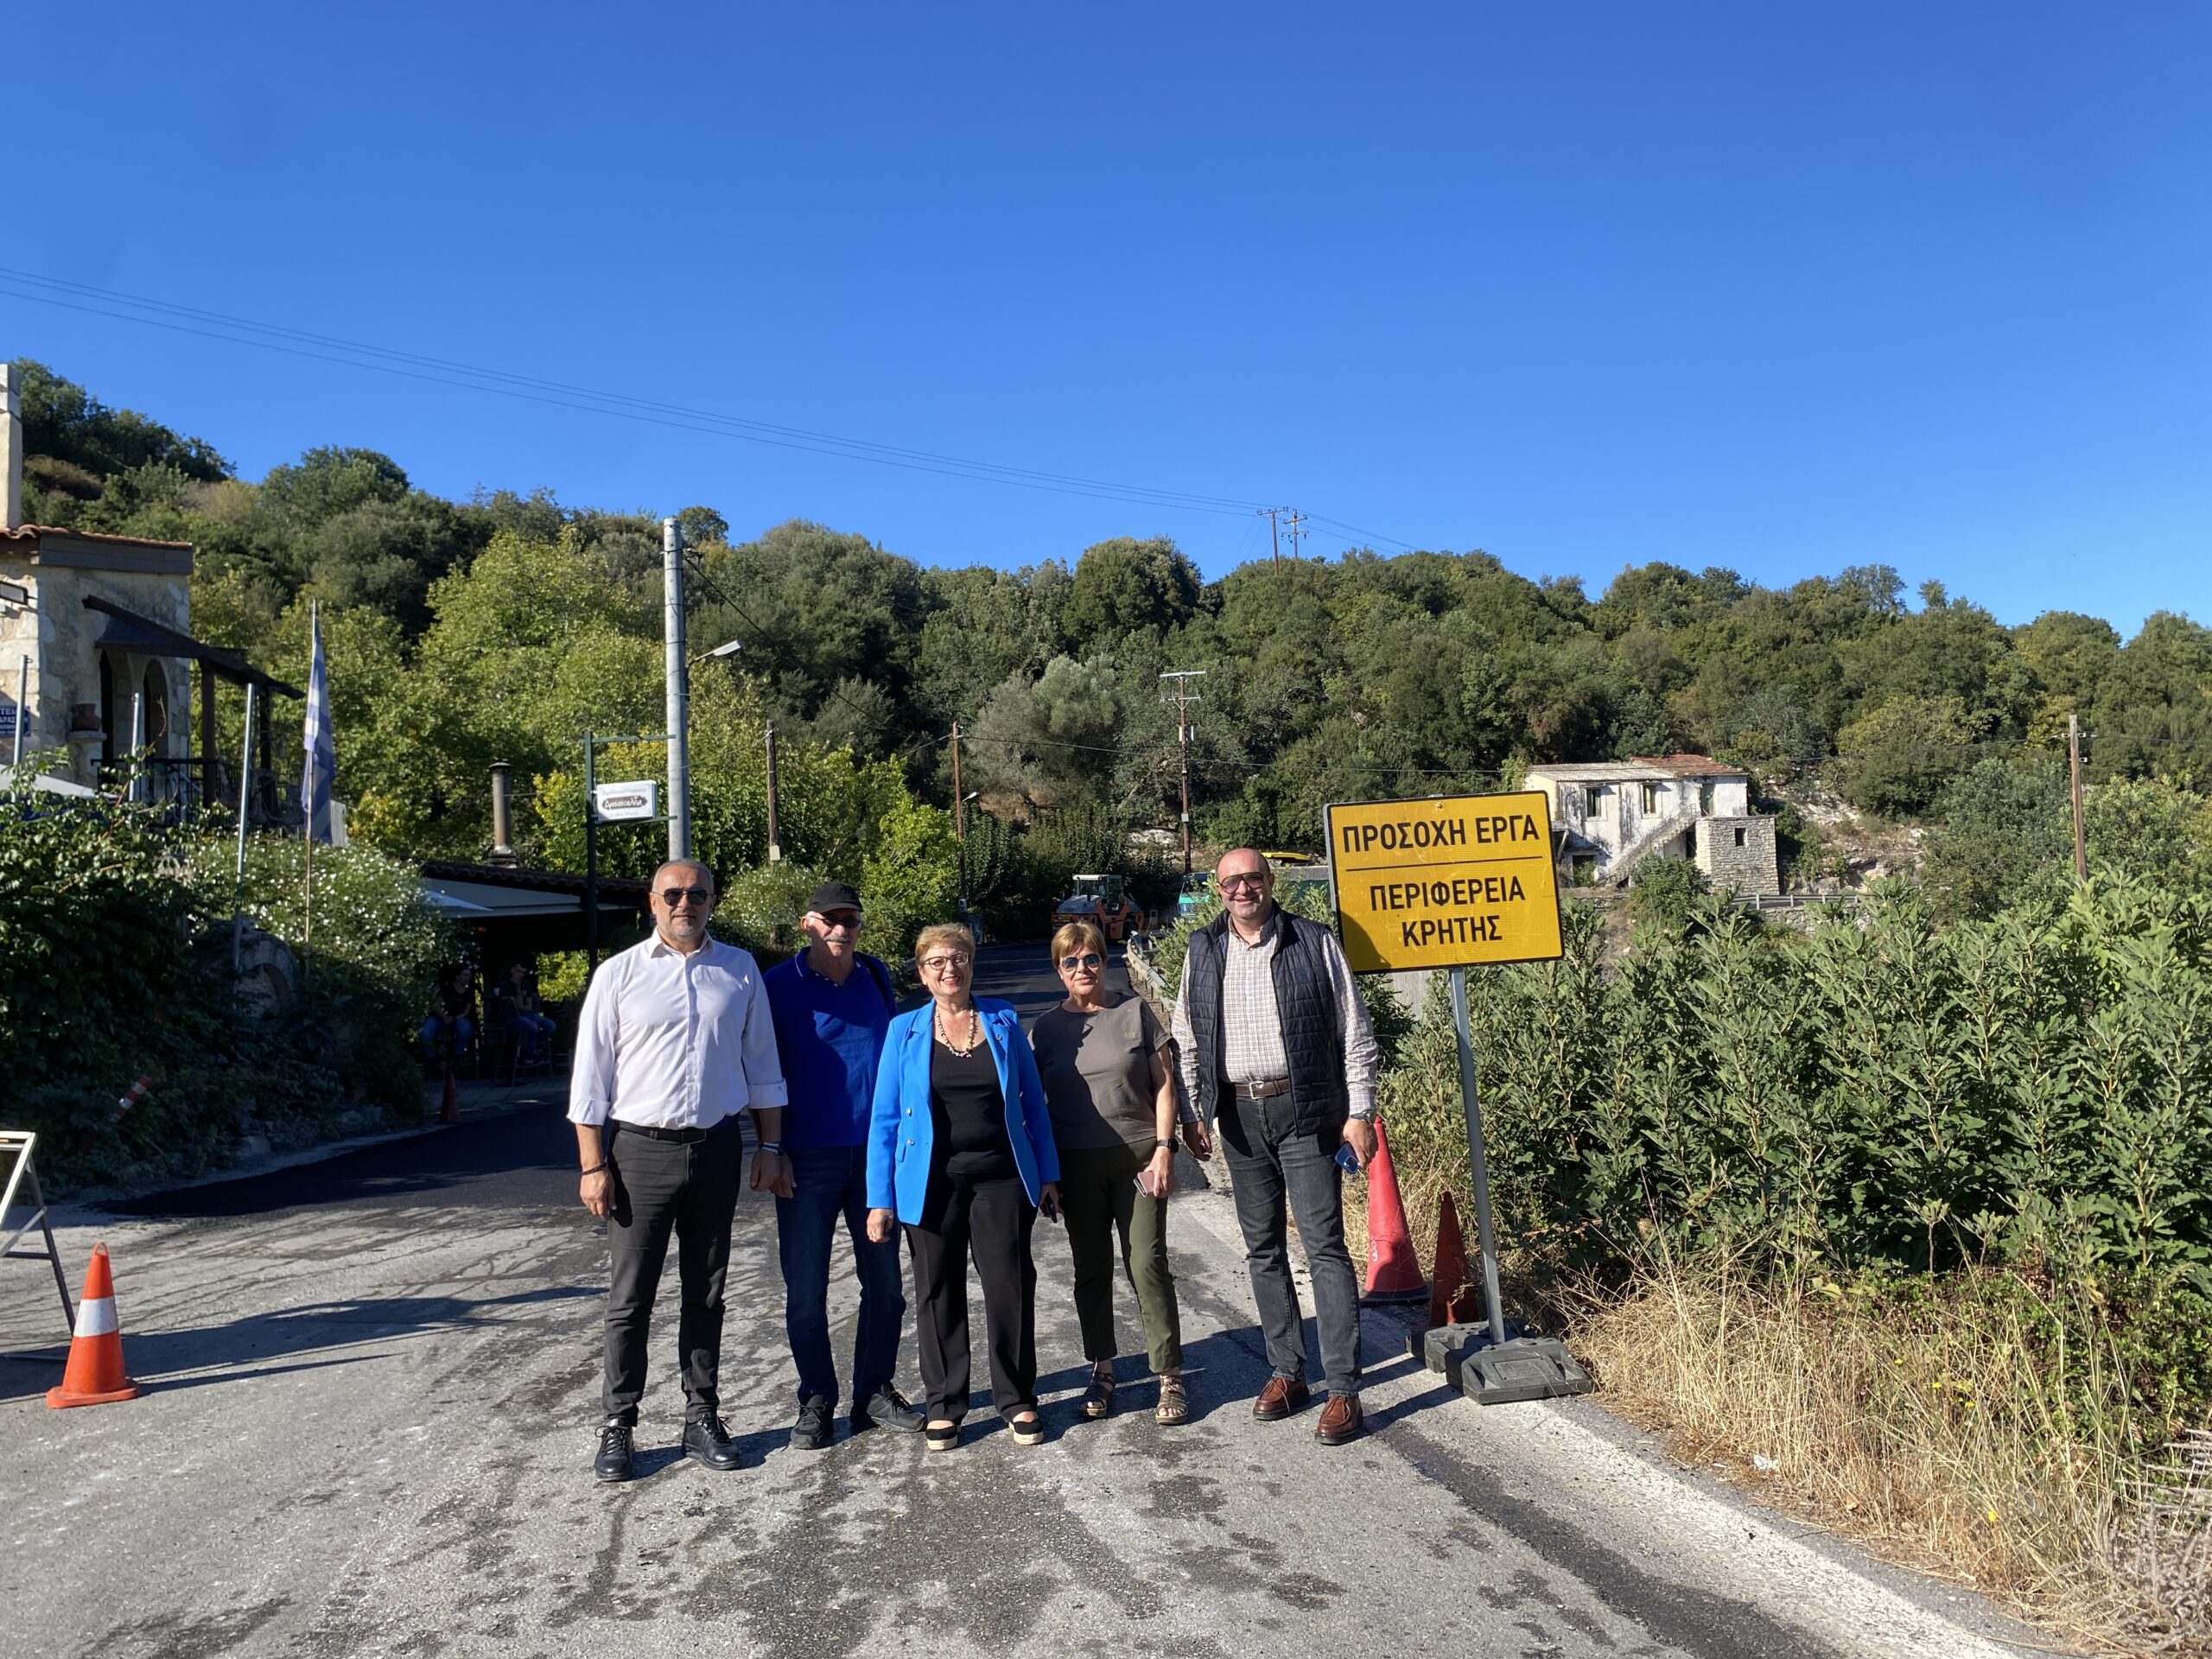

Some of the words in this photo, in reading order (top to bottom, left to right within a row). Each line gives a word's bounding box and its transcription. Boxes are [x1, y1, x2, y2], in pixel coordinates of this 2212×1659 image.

[1343, 818, 1466, 853] ΠΡΟΣΟΧΗ
[1475, 814, 1540, 843] ΕΡΓΑ
[1370, 875, 1526, 911] ΠΕΡΙΦΕΡΕΙΑ
[1402, 915, 1503, 947] ΚΡΗΤΗΣ
